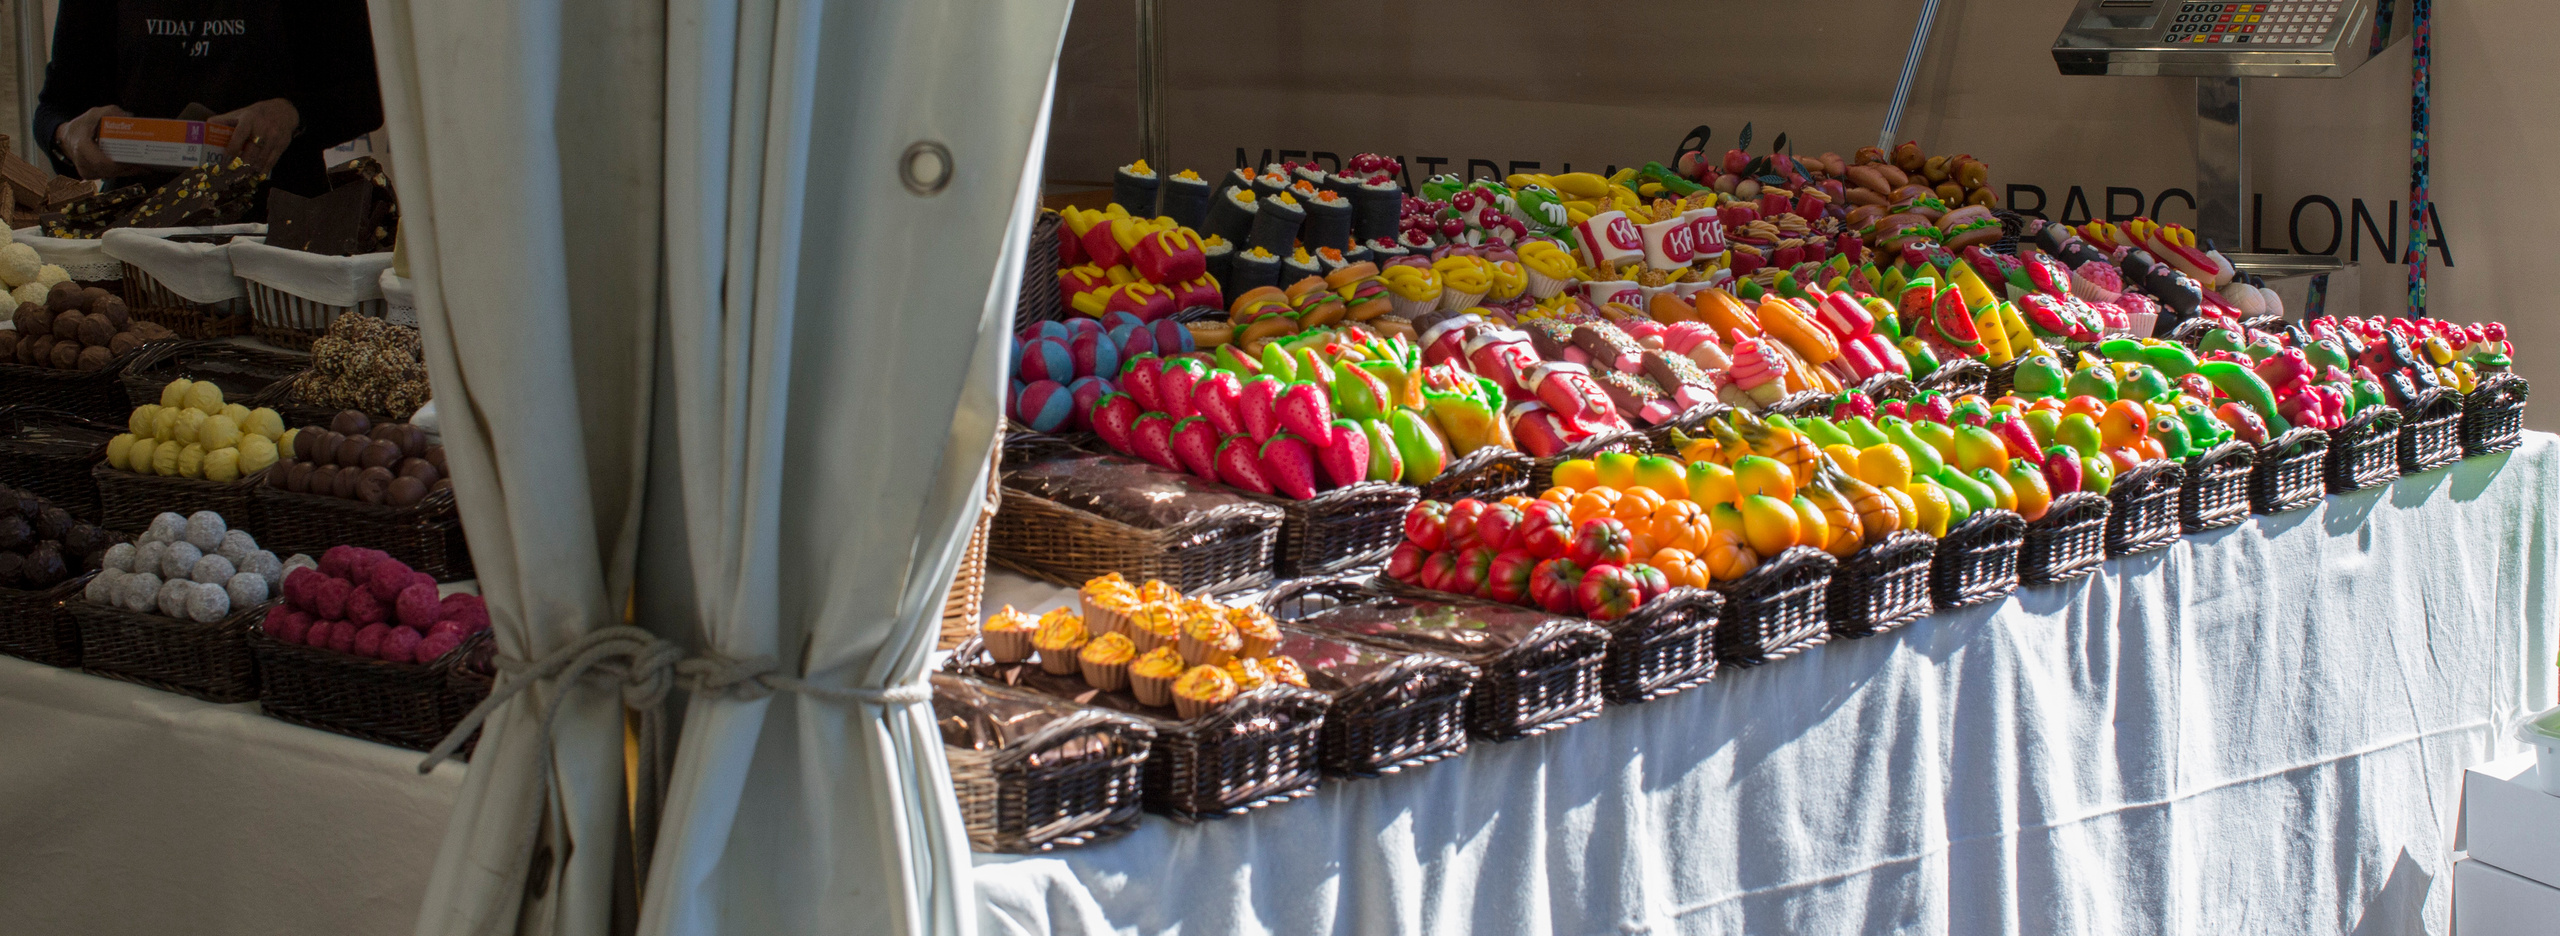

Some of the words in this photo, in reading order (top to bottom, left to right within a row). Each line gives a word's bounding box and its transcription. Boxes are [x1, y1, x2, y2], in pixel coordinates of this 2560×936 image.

[201, 18, 245, 36] PONS
[182, 41, 209, 56] 97
[2006, 183, 2455, 267] BARCLONA
